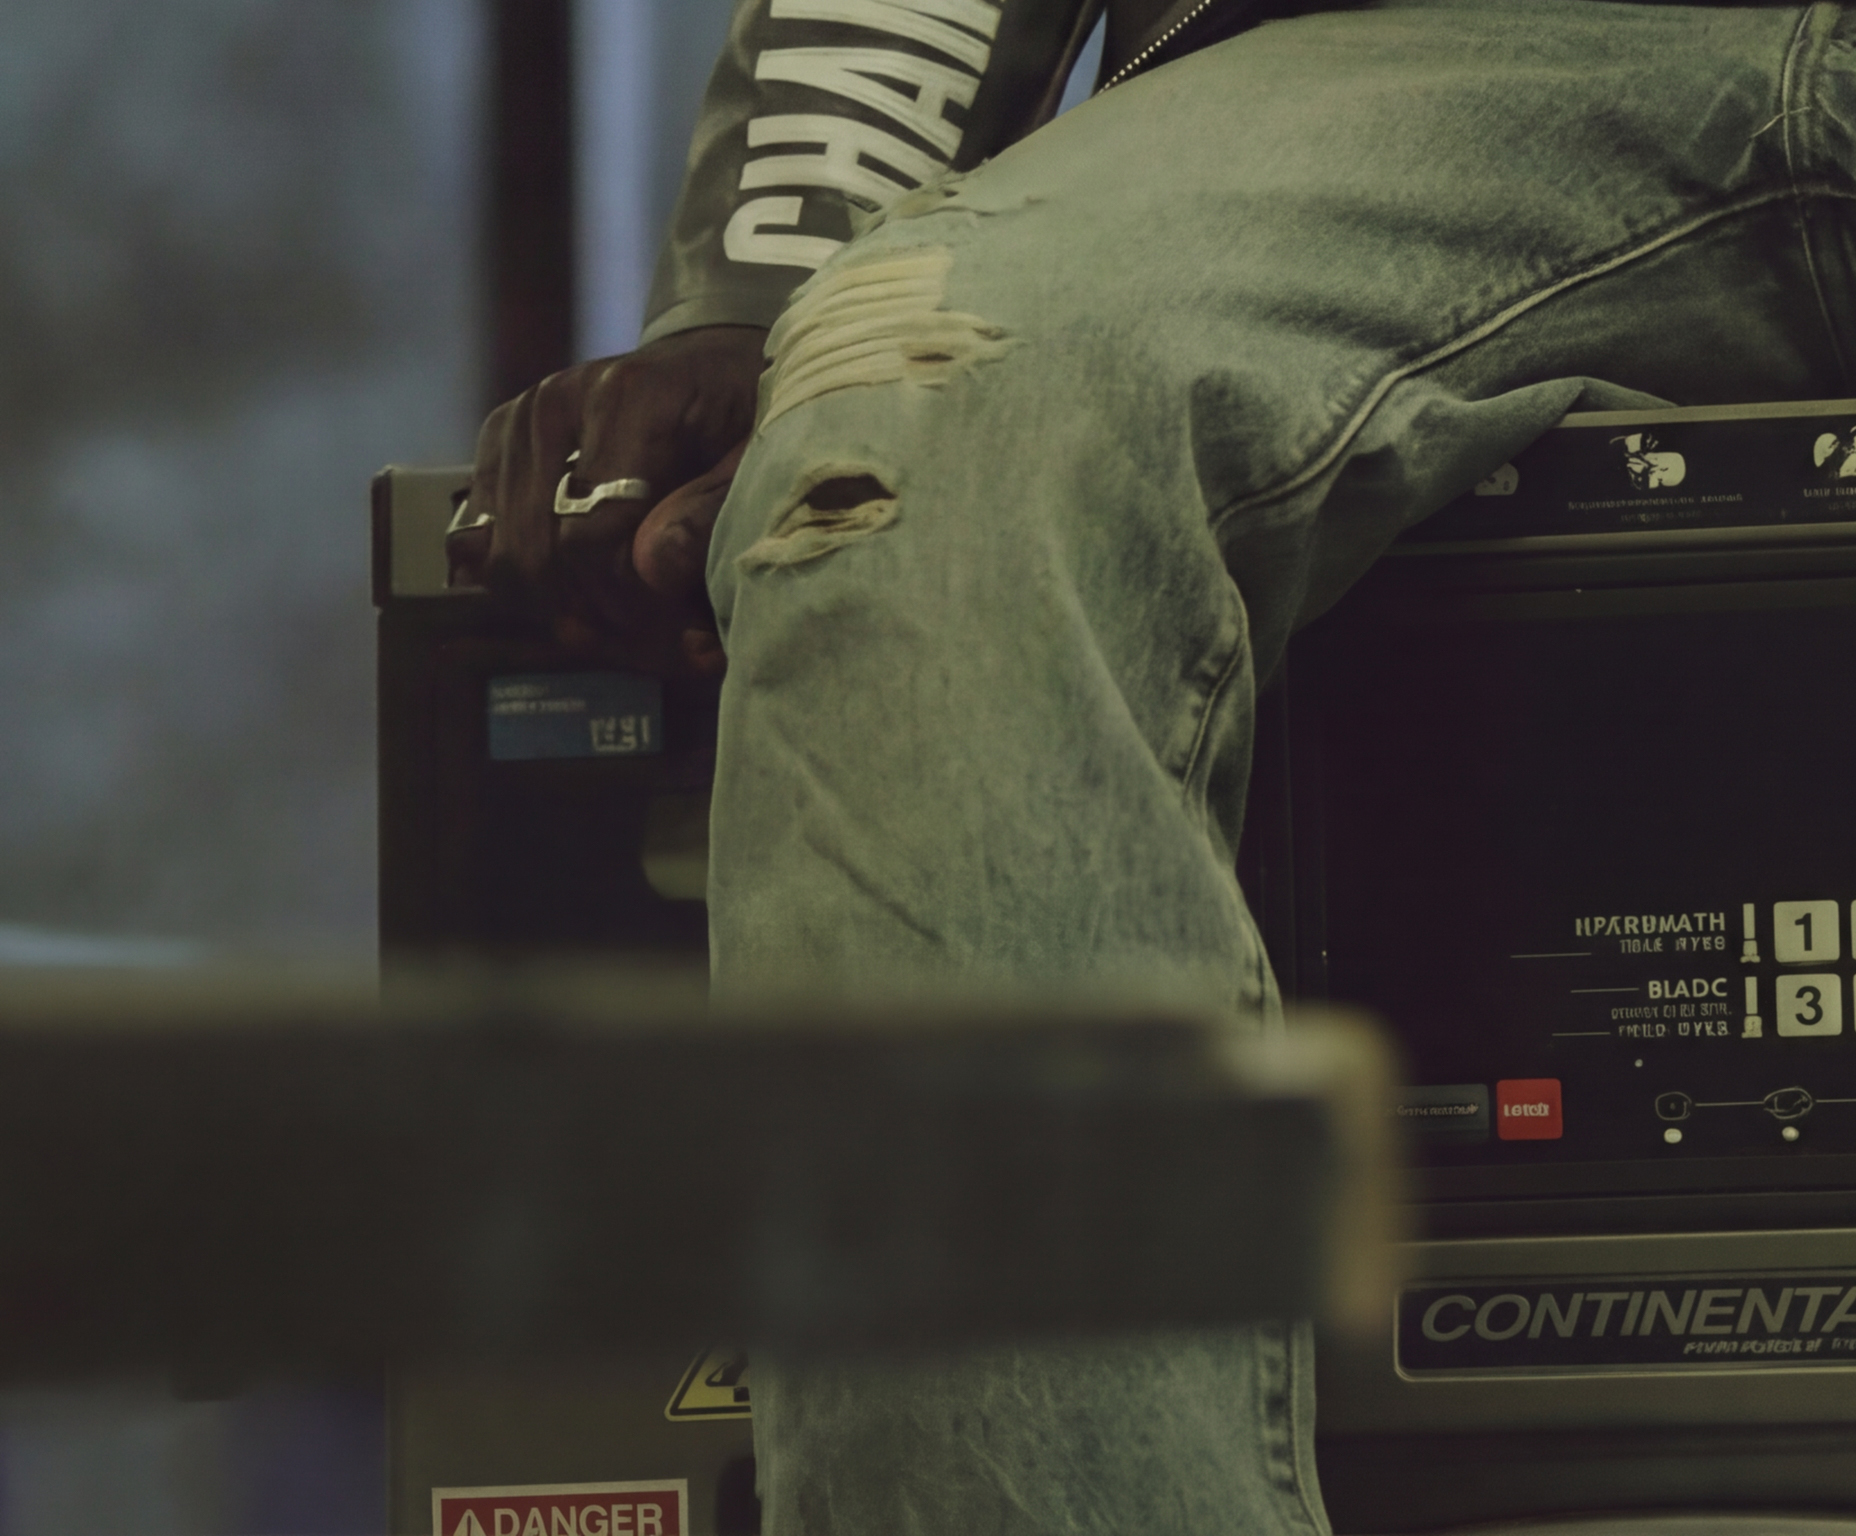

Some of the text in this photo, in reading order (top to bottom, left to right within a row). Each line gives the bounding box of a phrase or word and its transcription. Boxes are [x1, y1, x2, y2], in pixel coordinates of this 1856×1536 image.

[1794, 912, 1813, 951] 1
[1795, 985, 1824, 1026] 3
[494, 1502, 663, 1536] DANGER
